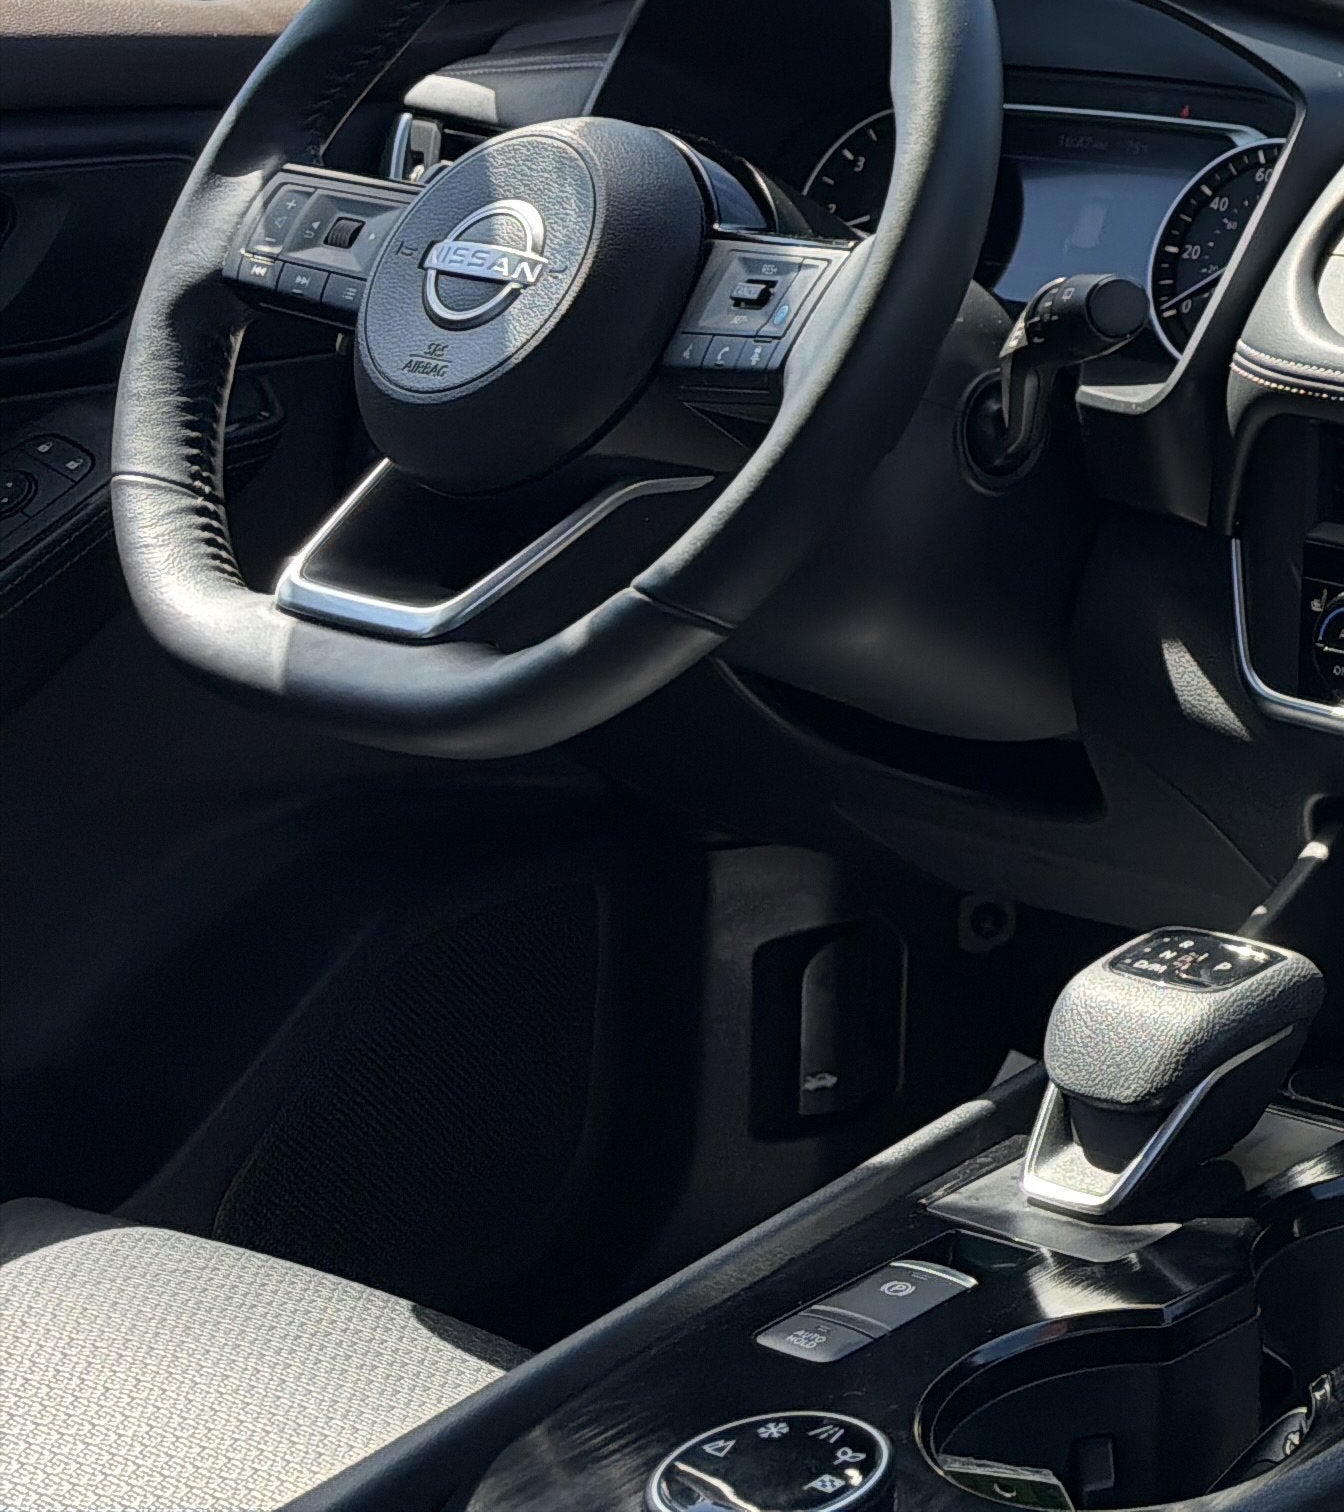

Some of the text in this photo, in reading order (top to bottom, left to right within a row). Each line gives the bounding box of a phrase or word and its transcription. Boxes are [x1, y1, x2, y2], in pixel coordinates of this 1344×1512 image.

[854, 156, 866, 173] 3
[1255, 167, 1272, 183] 60
[1209, 196, 1229, 212] 40
[1182, 244, 1201, 260] 20
[1181, 298, 1192, 313] 0
[401, 358, 451, 378] AIRBAG
[793, 1329, 828, 1343] AUTO
